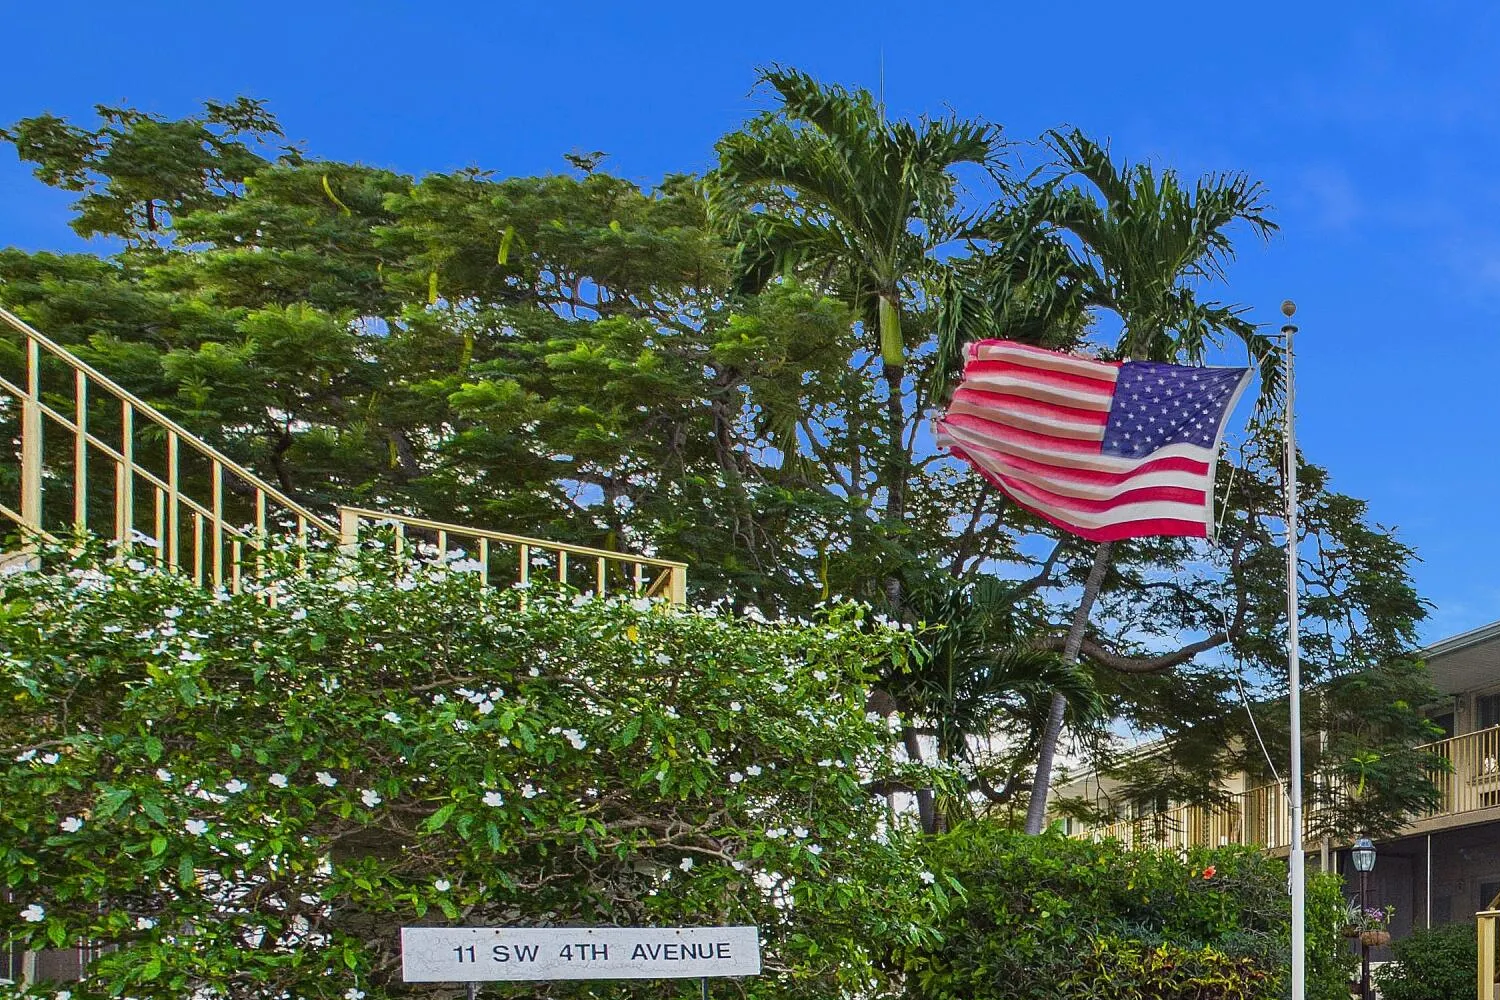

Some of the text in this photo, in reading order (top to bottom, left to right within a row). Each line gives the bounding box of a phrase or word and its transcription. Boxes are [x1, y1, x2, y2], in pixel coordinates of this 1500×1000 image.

[453, 942, 732, 963] 11 SW 4TH AVENUE
